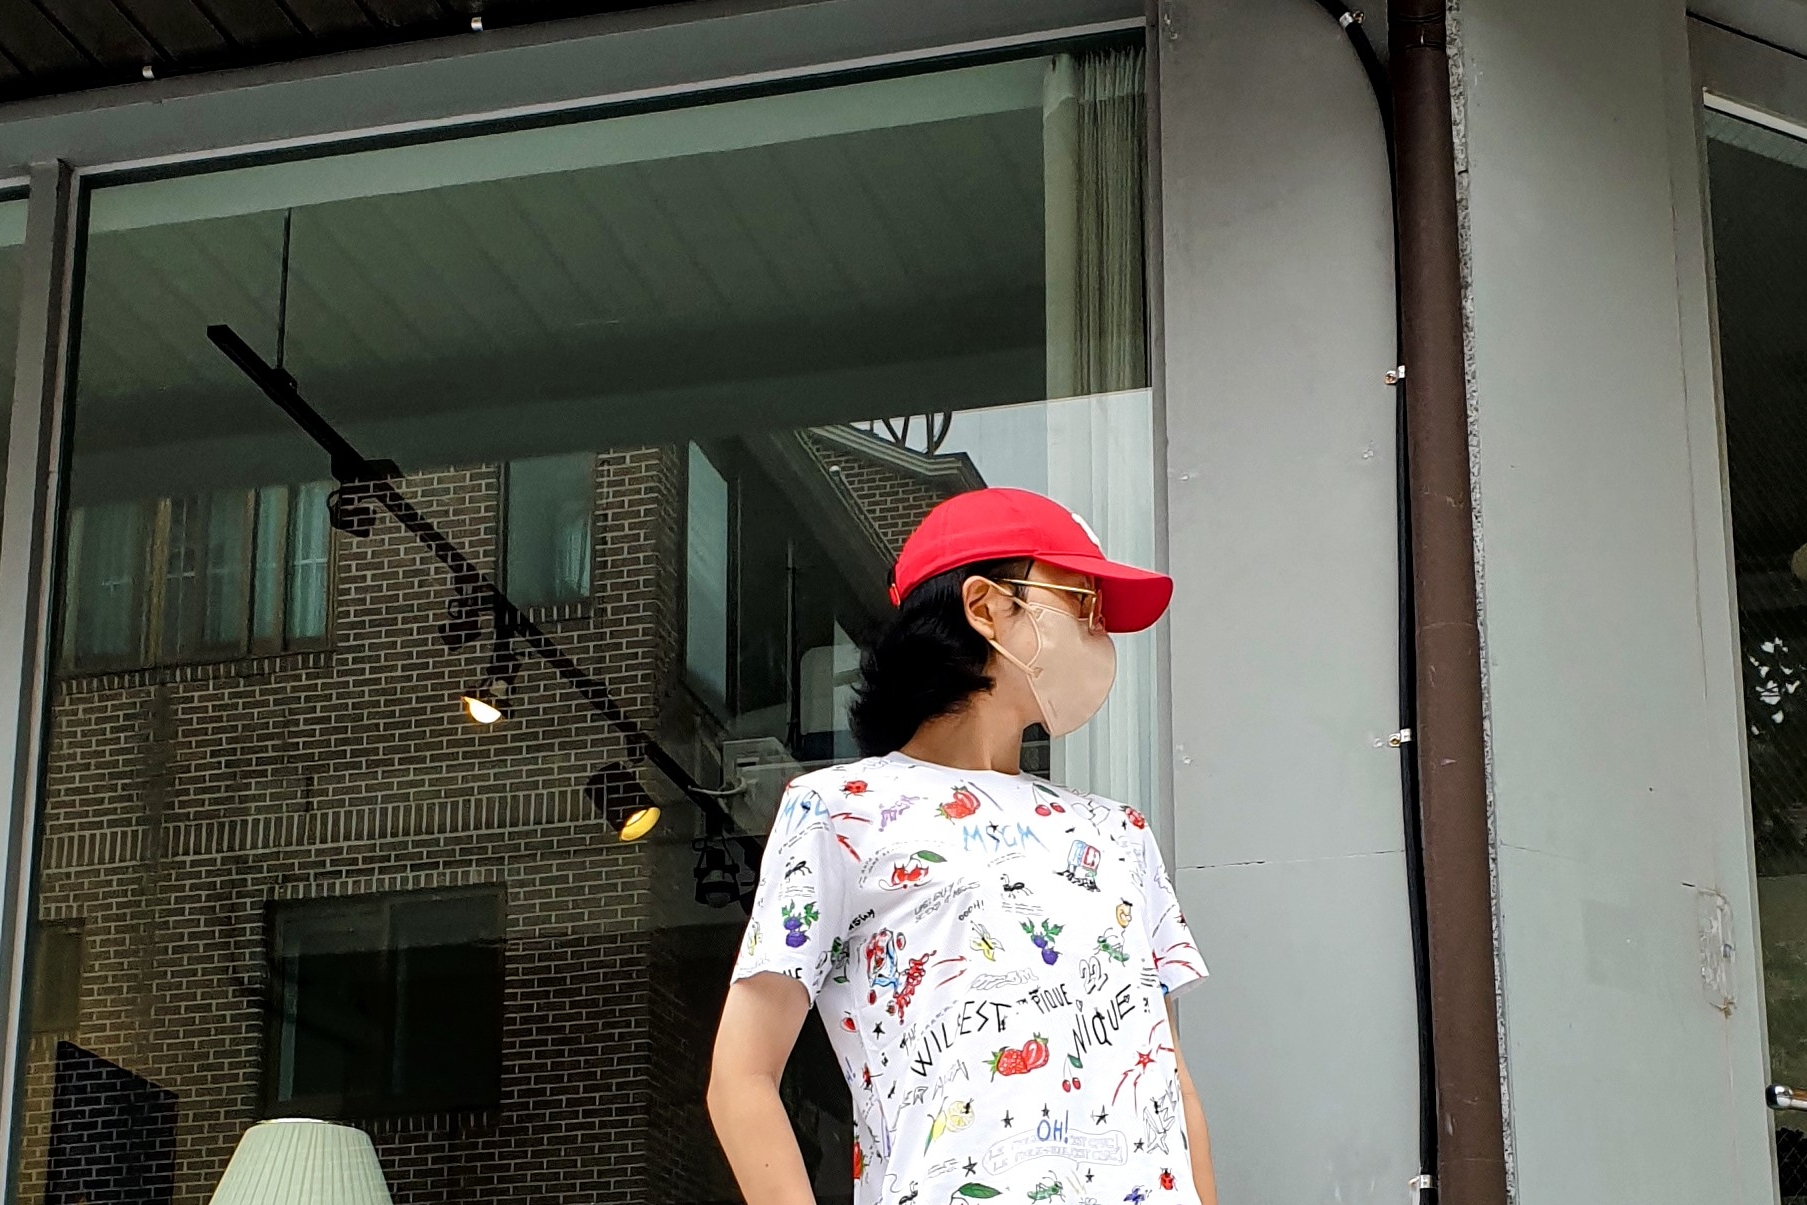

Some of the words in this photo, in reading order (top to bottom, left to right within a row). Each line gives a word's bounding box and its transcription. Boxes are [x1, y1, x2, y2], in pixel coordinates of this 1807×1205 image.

[962, 821, 1050, 852] MSGM
[911, 1000, 1012, 1077] WILEST
[1032, 984, 1073, 1014] PIQUE
[1072, 984, 1135, 1053] NIQUE
[1037, 1110, 1069, 1144] OH!
